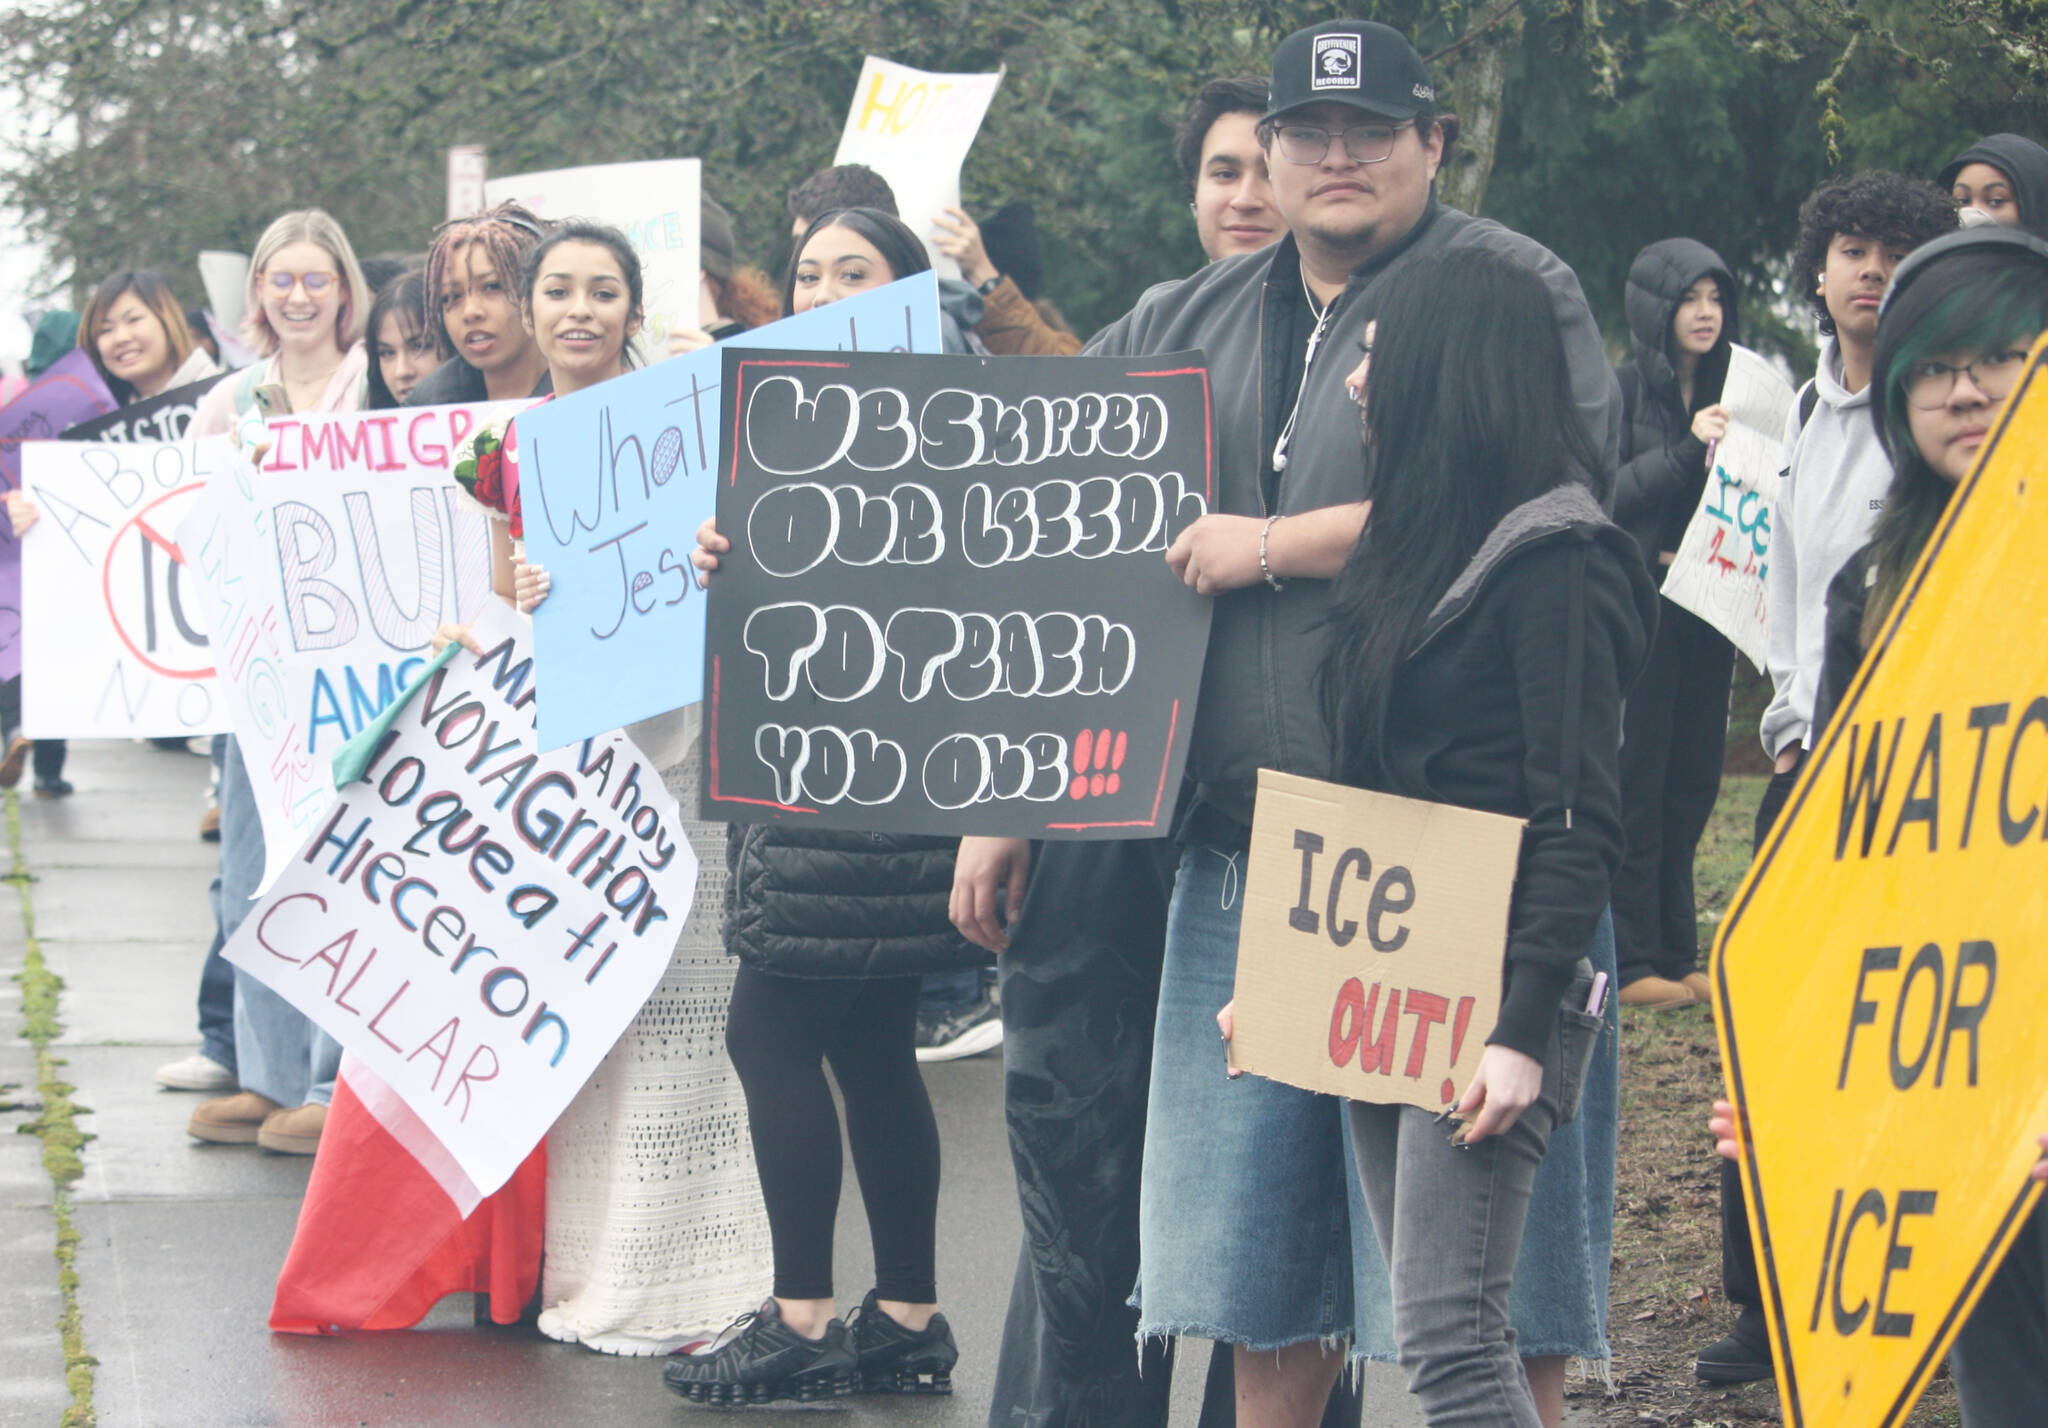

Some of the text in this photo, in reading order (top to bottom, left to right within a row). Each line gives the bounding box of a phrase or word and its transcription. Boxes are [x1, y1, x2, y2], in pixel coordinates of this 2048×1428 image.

[534, 373, 719, 546] What
[746, 375, 1168, 475] WE SKIPPED
[748, 472, 1208, 577] OUR LESSON
[743, 601, 1136, 702] TO TEACH
[611, 762, 677, 868] hoy
[755, 723, 907, 806] YOU
[1834, 694, 2048, 861] WATC
[506, 883, 559, 930] a
[1289, 829, 1416, 953] Ice
[257, 893, 500, 1123] CALLAR
[1328, 976, 1476, 1105] OUT!
[1837, 939, 1997, 1092] FOR
[1809, 1188, 1938, 1338] ICE
